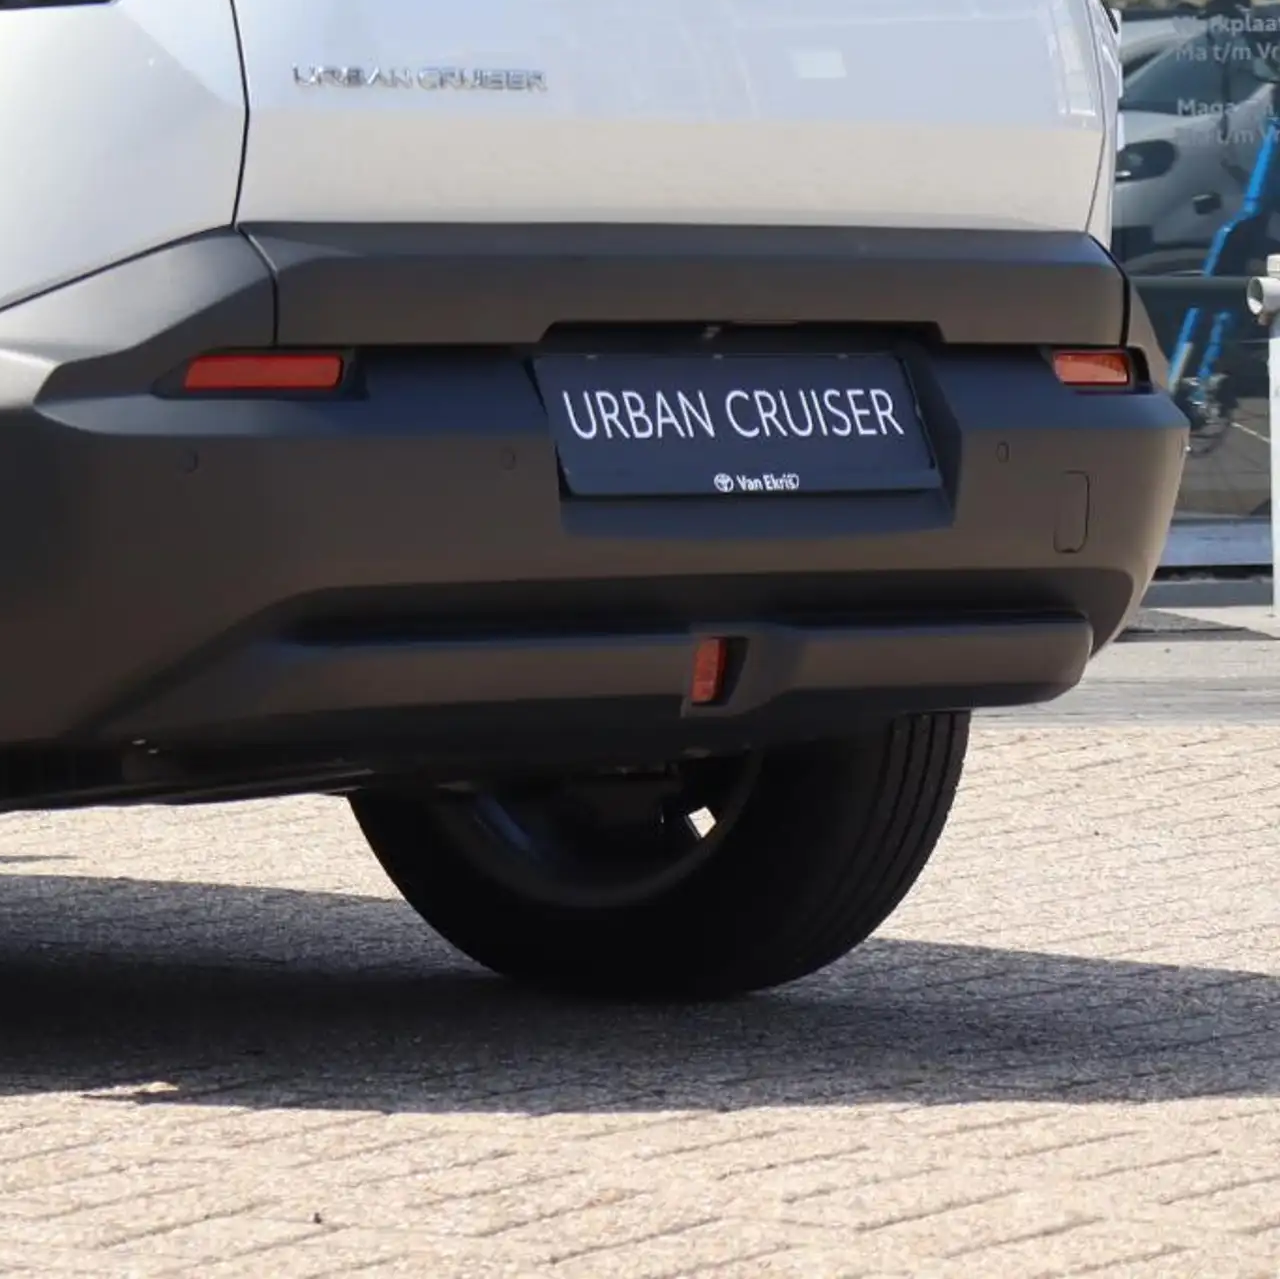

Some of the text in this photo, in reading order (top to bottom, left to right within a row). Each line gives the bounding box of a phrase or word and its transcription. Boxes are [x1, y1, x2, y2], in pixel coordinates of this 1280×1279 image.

[563, 388, 906, 440] URBAN CRUISER
[736, 474, 763, 490] Van
